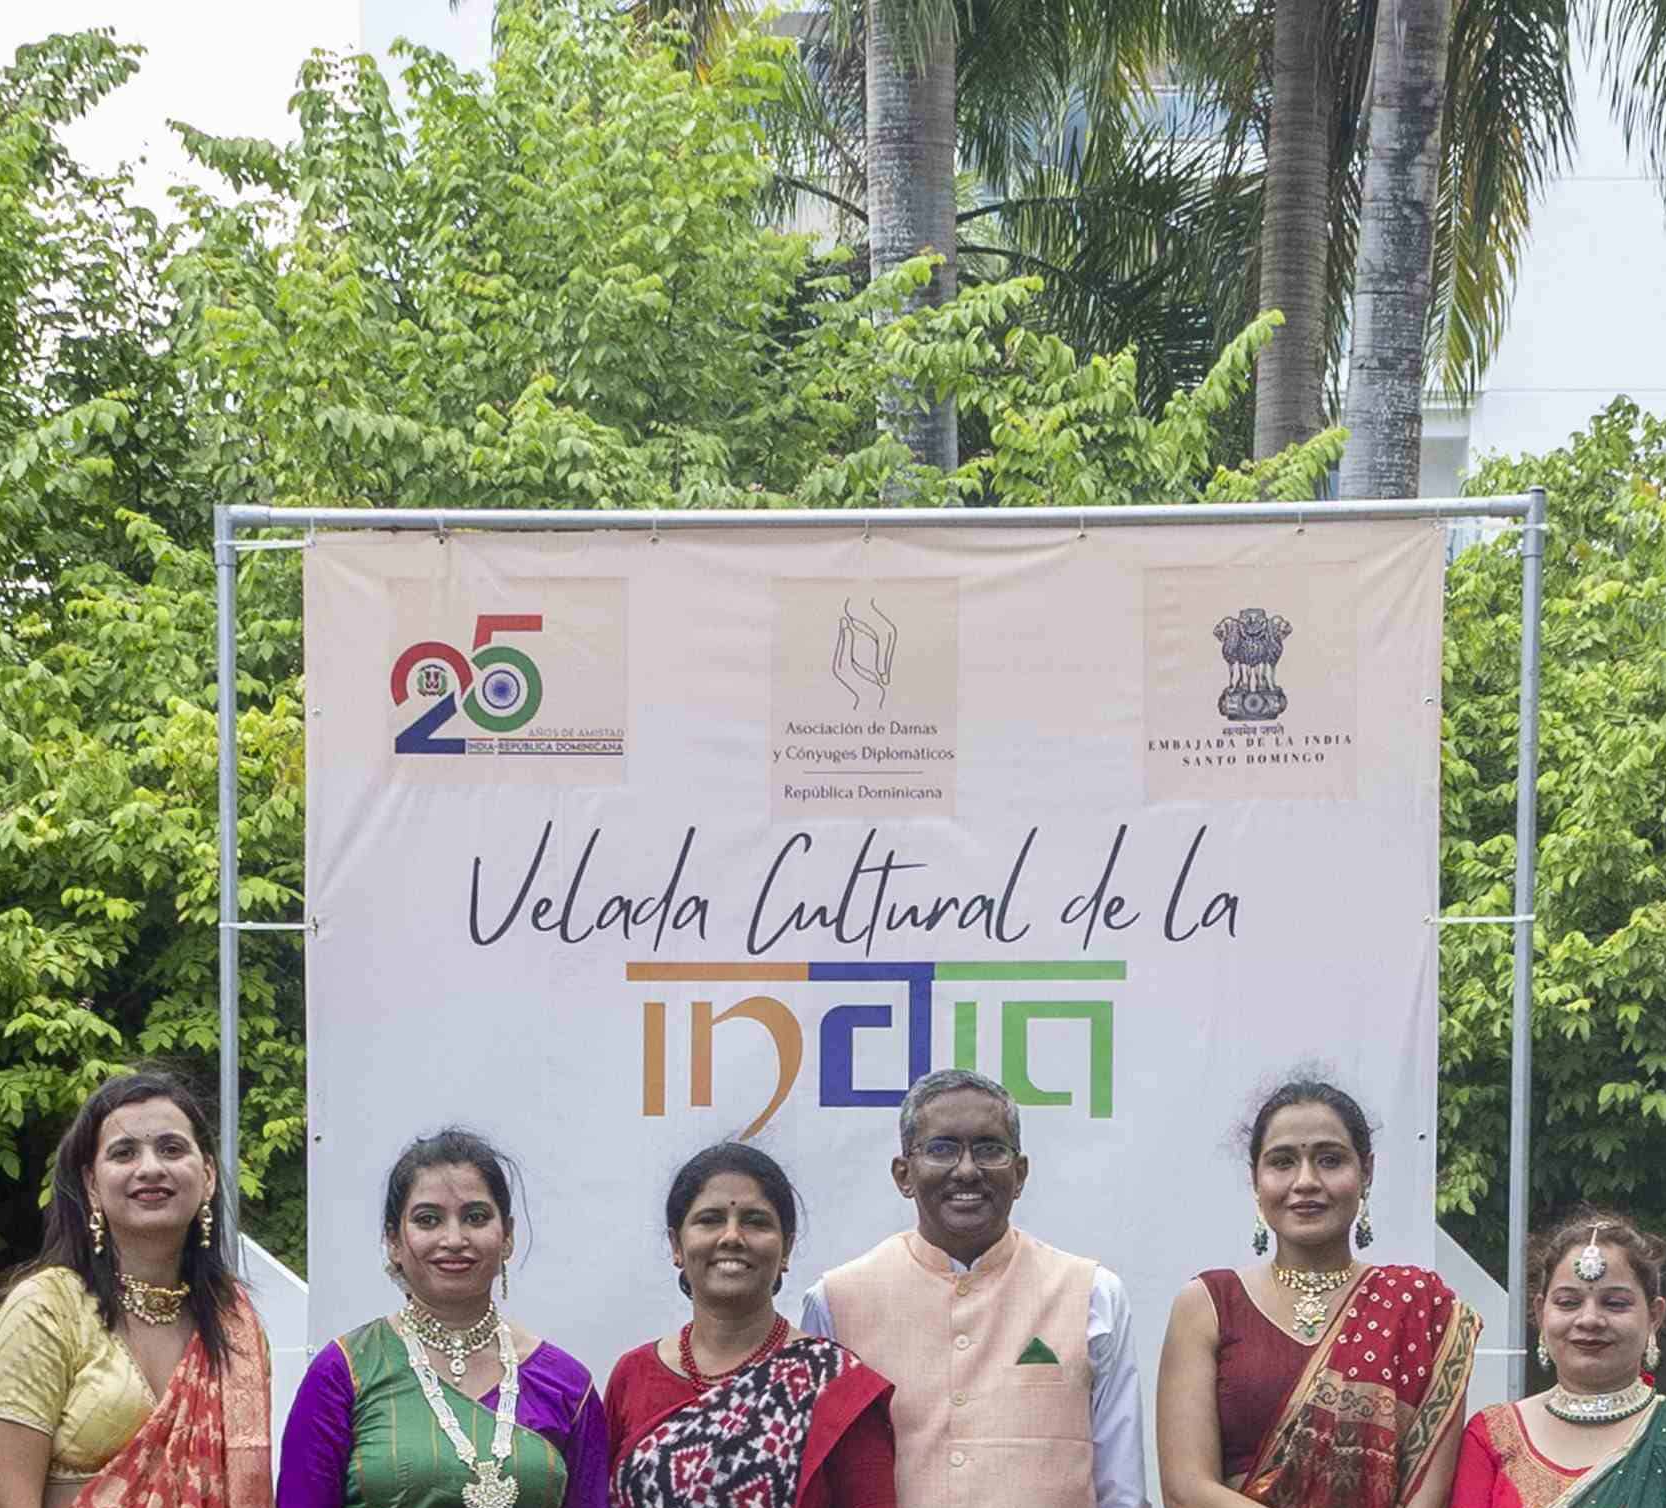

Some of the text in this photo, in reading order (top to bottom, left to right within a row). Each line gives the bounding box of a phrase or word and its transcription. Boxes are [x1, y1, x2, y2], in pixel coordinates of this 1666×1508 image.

[390, 614, 543, 754] 25
[577, 727, 625, 738] AMISTAD
[785, 721, 938, 735] Asociación de Damas
[555, 742, 623, 752] DOMINICANA
[1148, 734, 1352, 751] EMBAJADA DE LA INDIA
[772, 746, 955, 763] y Cónyuges Diplomáticos
[1182, 752, 1325, 767] SANTO DOMINGO
[784, 784, 943, 803] República Dominicana
[469, 821, 710, 952] Velada
[746, 827, 1032, 957] Cultural
[1060, 824, 1140, 951] de
